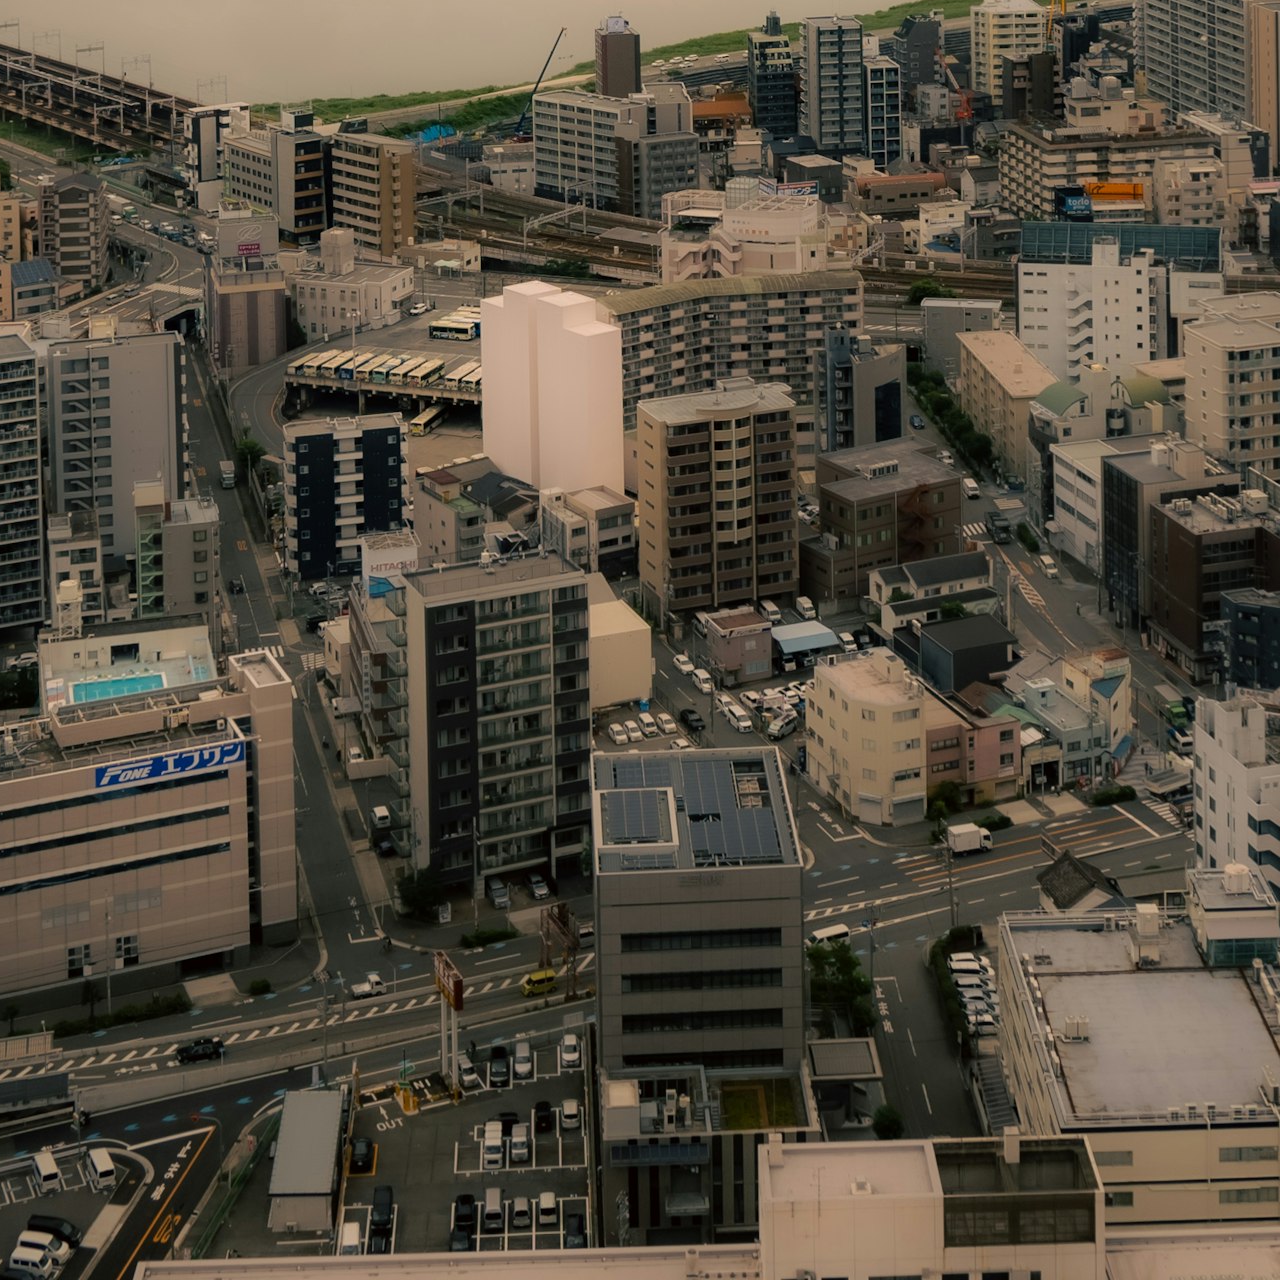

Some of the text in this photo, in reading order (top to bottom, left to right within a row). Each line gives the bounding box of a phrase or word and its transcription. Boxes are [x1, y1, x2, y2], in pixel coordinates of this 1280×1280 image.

[370, 560, 416, 572] HITACHI
[161, 744, 242, 776] エフワン
[376, 1117, 403, 1131] OUT
